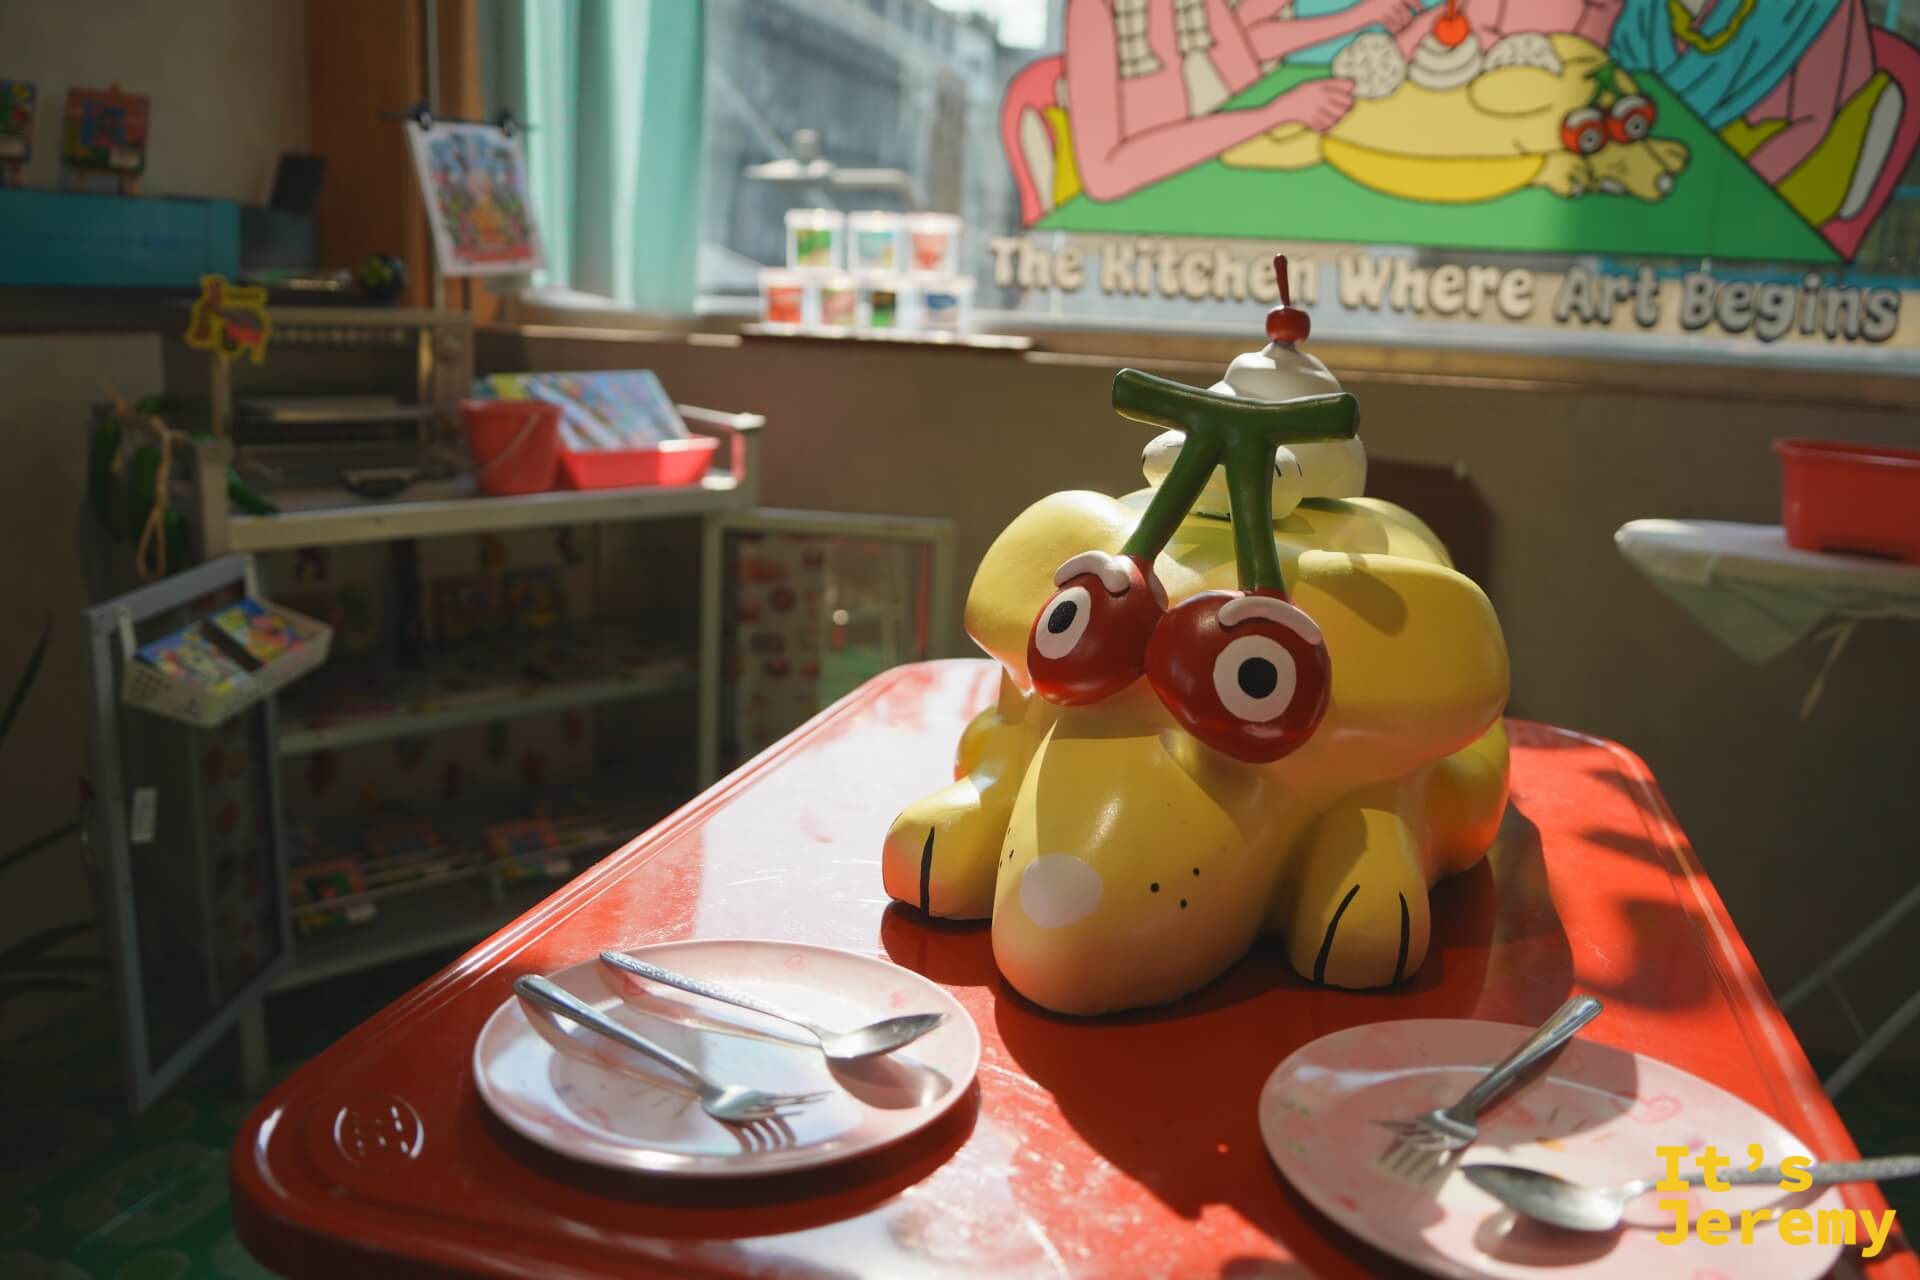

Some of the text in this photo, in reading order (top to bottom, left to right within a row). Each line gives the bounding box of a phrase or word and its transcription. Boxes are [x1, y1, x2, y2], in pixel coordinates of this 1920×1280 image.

[990, 236, 1900, 342] The Kitchen Where Art Begins
